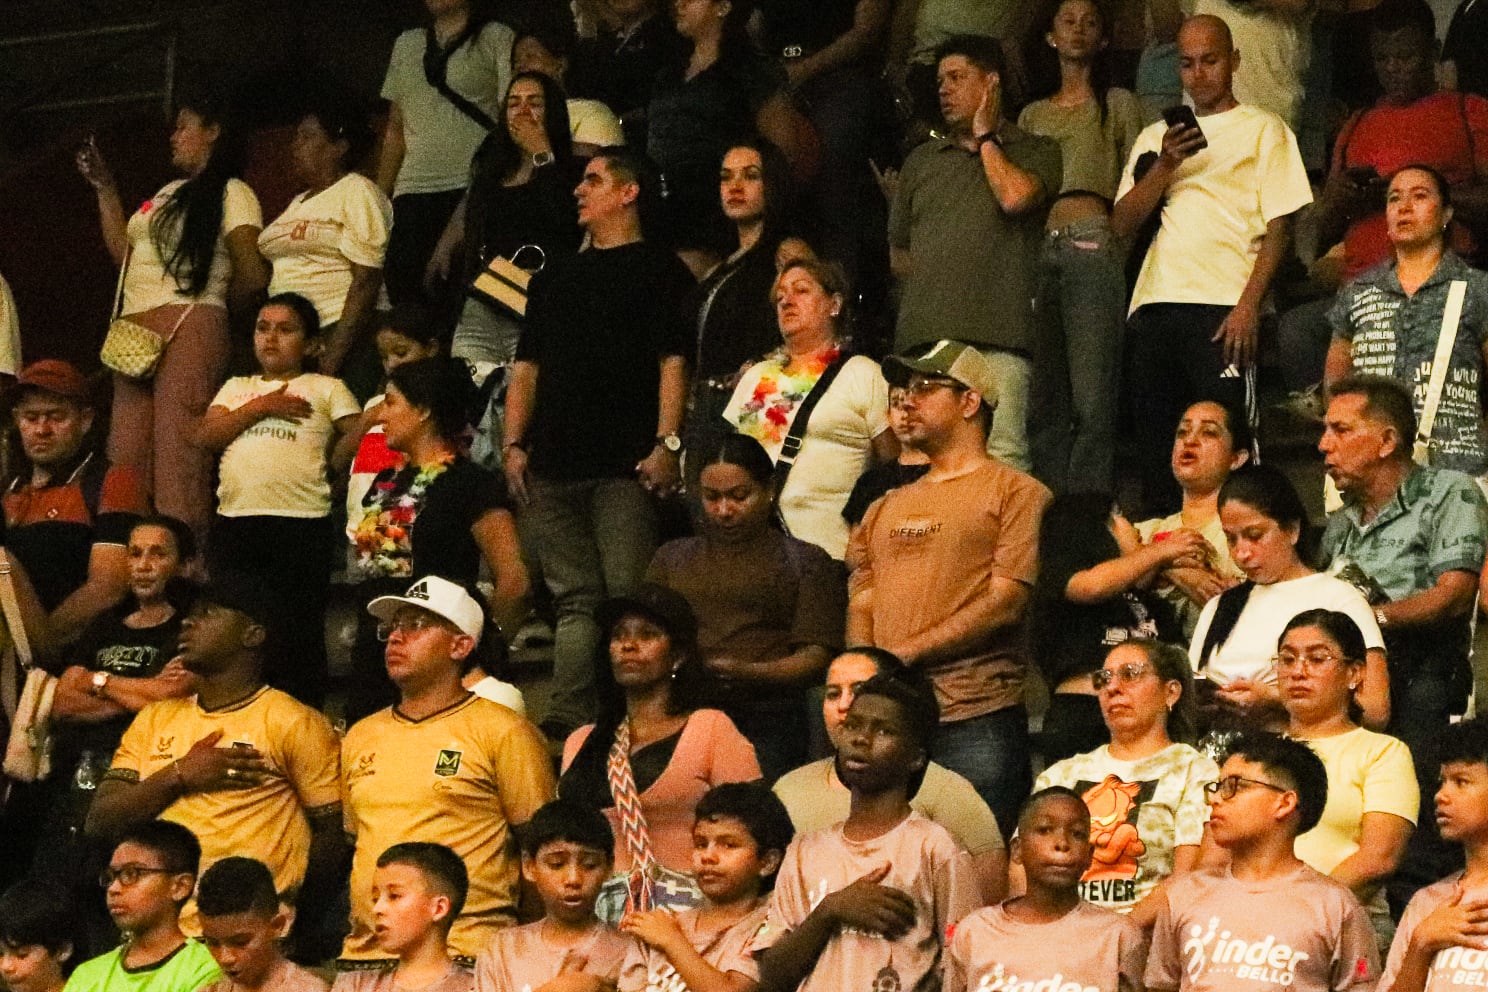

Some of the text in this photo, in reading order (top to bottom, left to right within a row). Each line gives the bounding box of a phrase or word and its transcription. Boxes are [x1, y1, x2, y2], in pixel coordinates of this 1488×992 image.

[1414, 361, 1431, 382] JU
[1414, 383, 1429, 398] AN
[246, 427, 297, 442] MPION
[1080, 879, 1136, 902] TEVER
[1211, 930, 1310, 972] inder
[1236, 965, 1294, 986] BELLO
